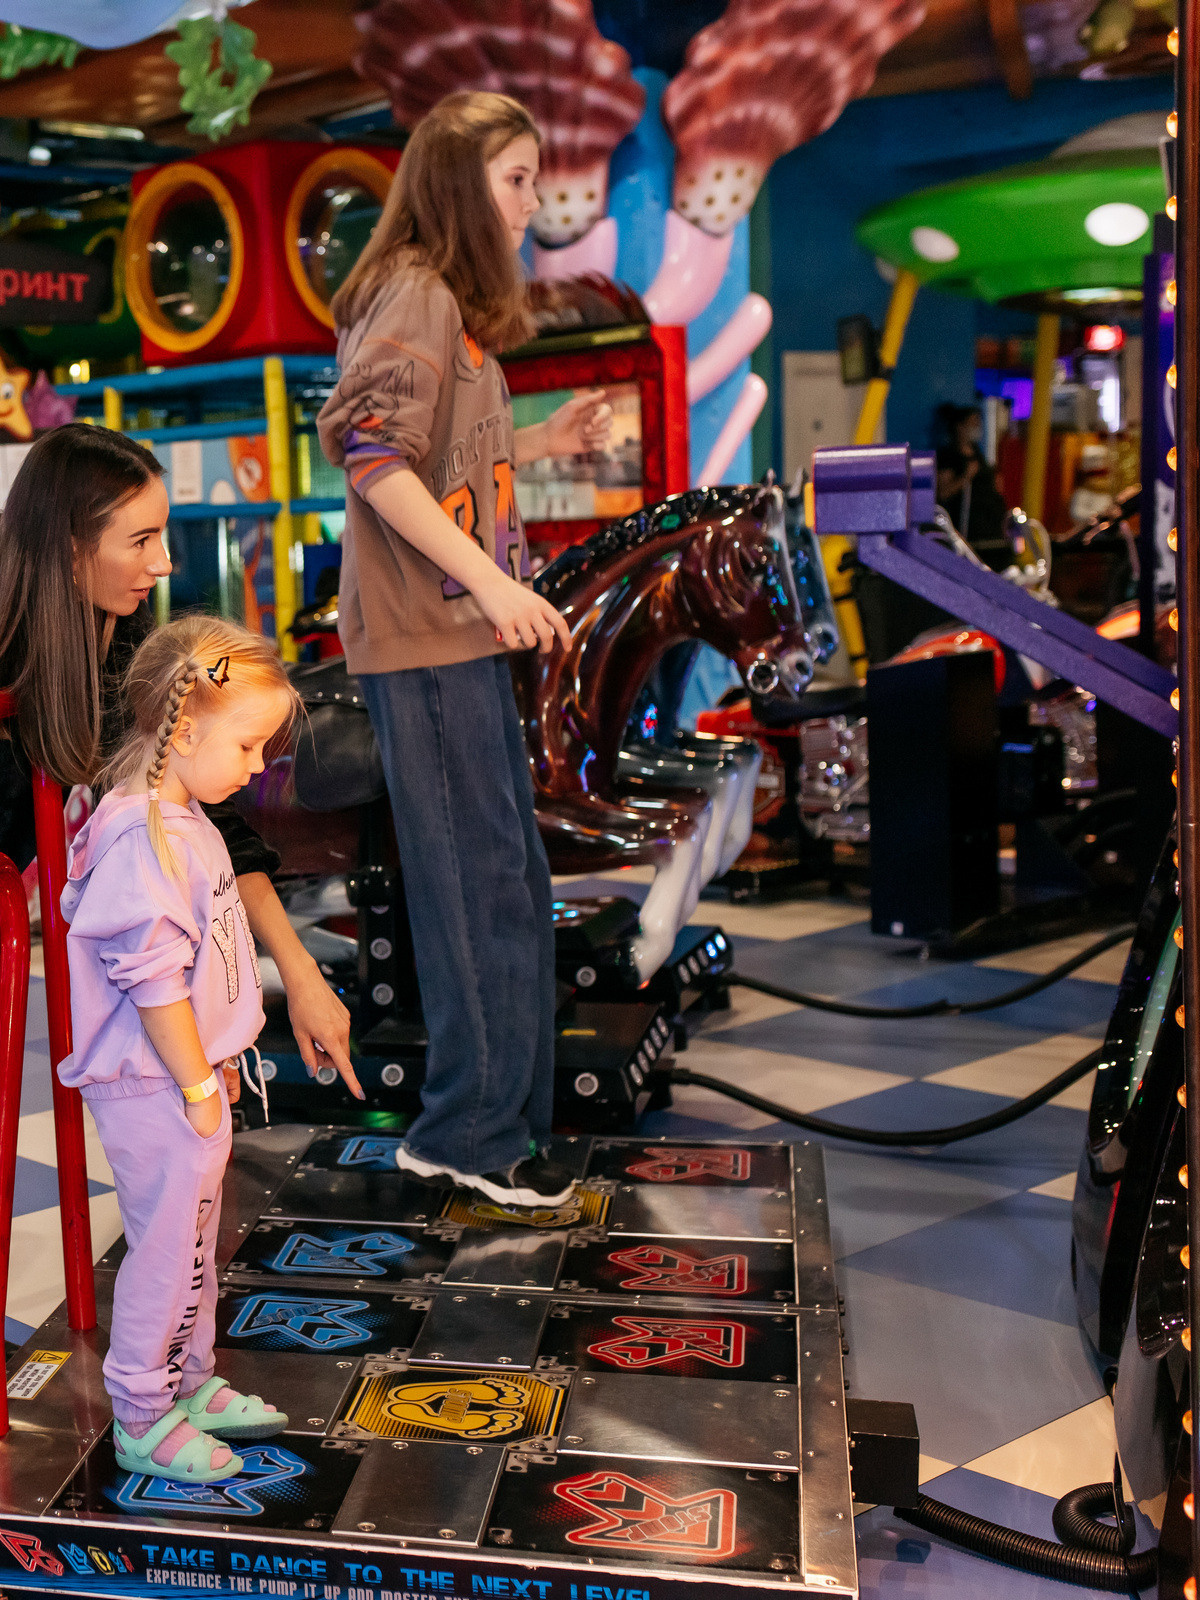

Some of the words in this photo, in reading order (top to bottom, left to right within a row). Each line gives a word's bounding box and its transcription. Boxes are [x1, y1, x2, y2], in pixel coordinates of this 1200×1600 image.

[627, 1506, 712, 1543] STOMP
[142, 1544, 215, 1568] TAKE
[230, 1552, 327, 1578] DANCE
[344, 1562, 383, 1584] TO
[400, 1568, 455, 1590] THE
[471, 1574, 553, 1599] NEXT
[146, 1568, 222, 1590] EXPERIENCE
[228, 1576, 253, 1593] THE
[259, 1579, 297, 1597] PUMP
[304, 1583, 317, 1599] IT
[324, 1584, 341, 1600] UP
[348, 1587, 378, 1600] AND
